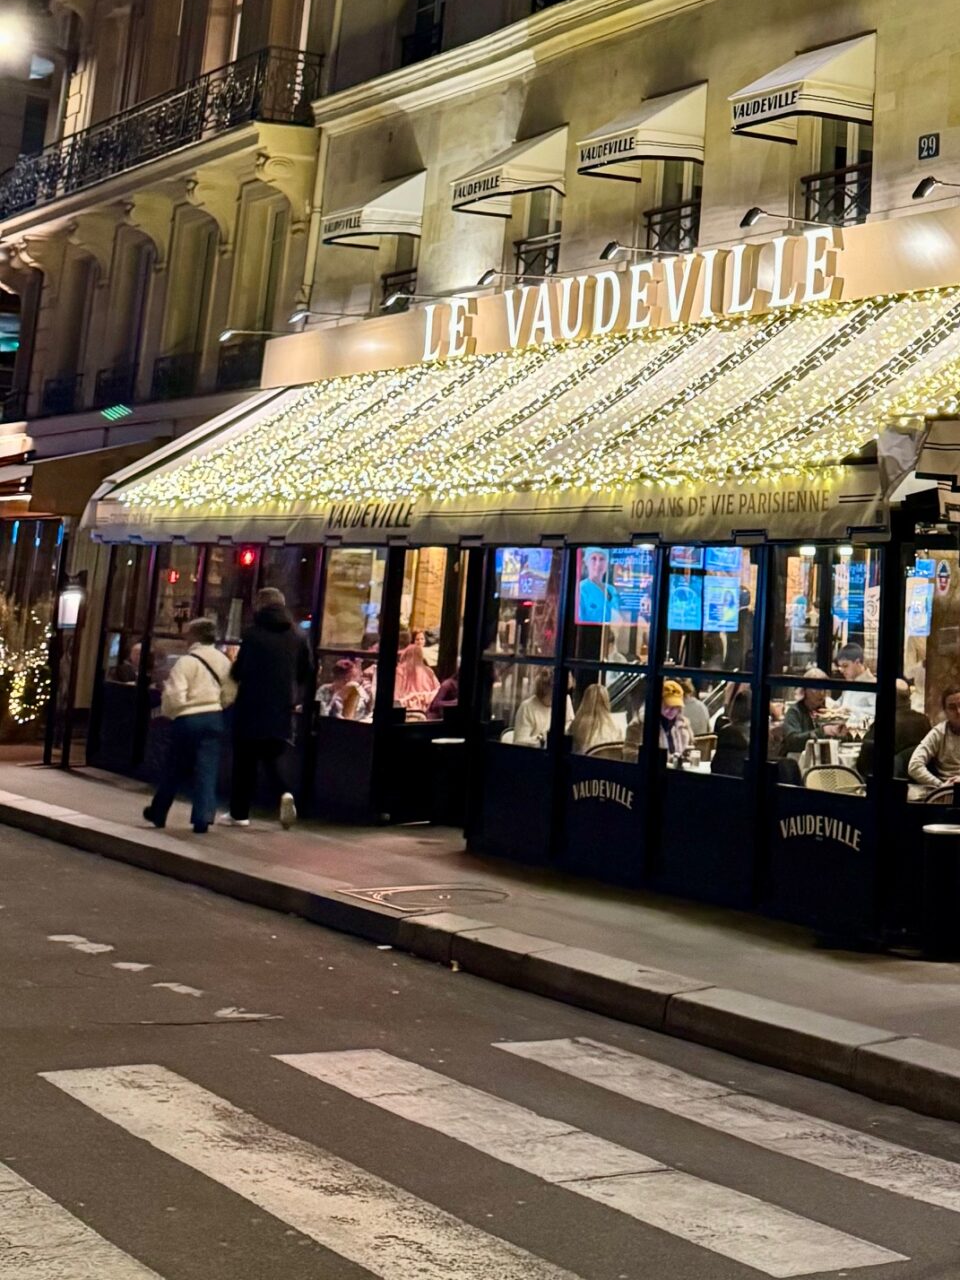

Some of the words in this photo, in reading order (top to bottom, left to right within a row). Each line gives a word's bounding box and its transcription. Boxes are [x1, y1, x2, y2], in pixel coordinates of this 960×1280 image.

[733, 90, 799, 120] VAUDEVILLE
[580, 136, 635, 163] VAUDEVILLE
[921, 136, 936, 157] 29
[453, 175, 500, 201] VAUDEVILLE
[421, 298, 470, 362] LE
[504, 229, 836, 348] VAUDEVILLE
[327, 503, 415, 529] VAUDEVILLE
[630, 499, 653, 519] 100
[656, 496, 683, 519] ANS
[687, 495, 707, 517] DE
[711, 493, 735, 516] VIE
[738, 490, 830, 514] PARISIENNE
[573, 780, 633, 809] VAUDEVILLE
[780, 815, 861, 851] VAUDEVILLE
